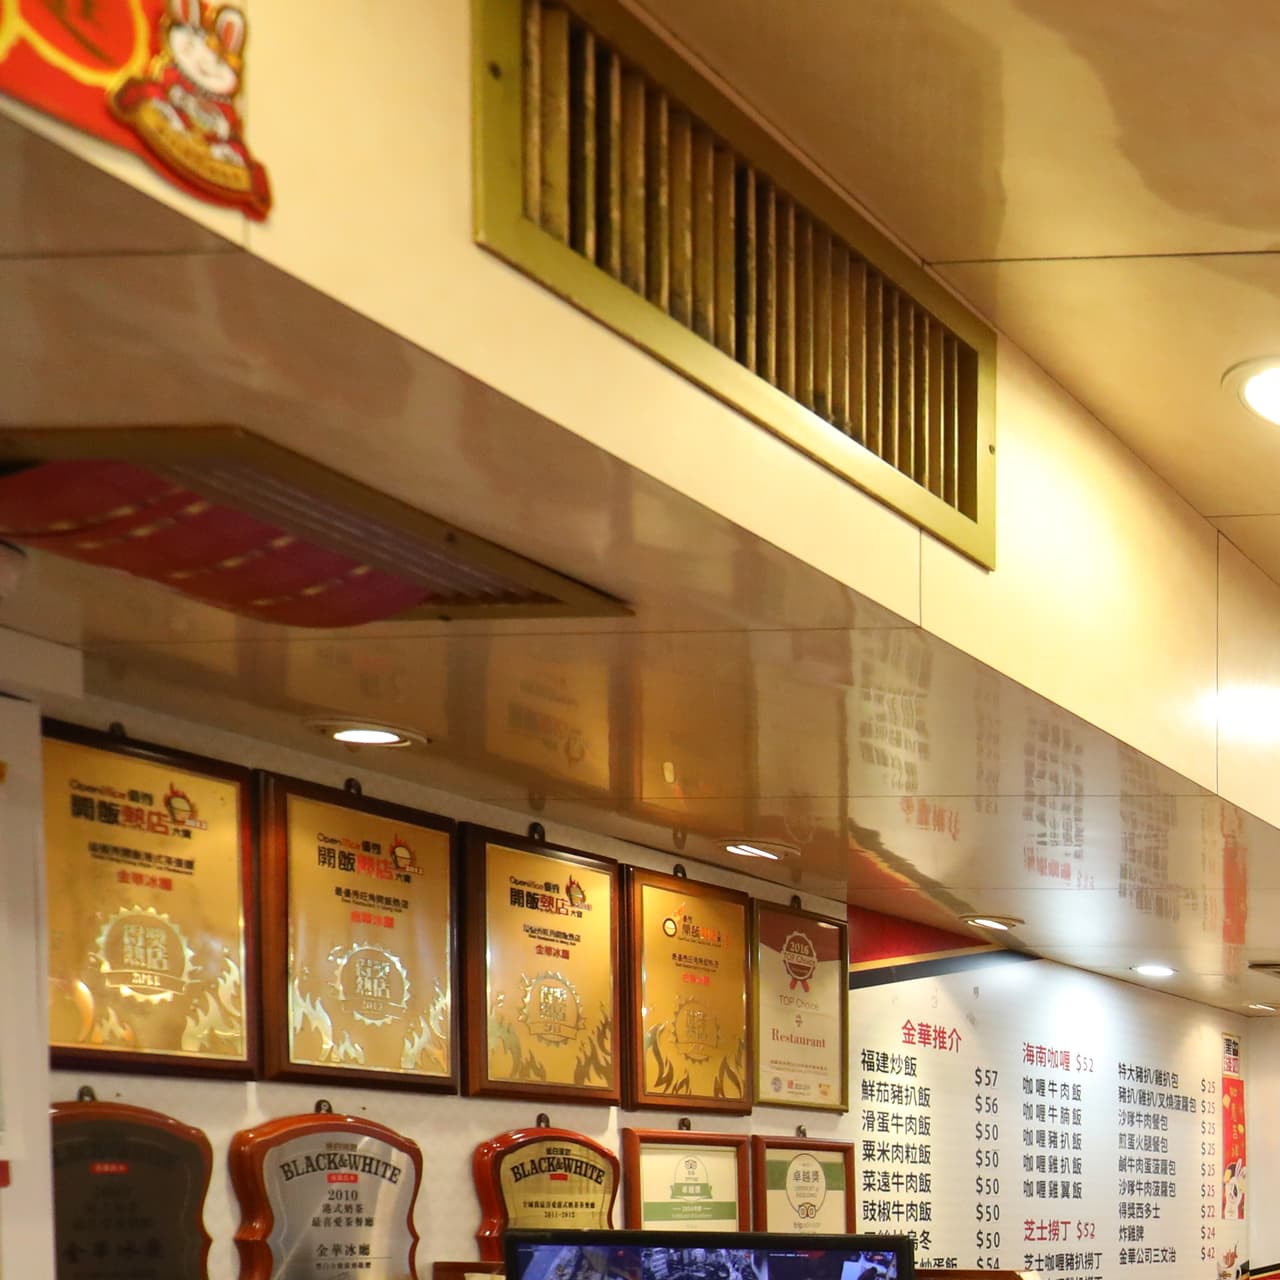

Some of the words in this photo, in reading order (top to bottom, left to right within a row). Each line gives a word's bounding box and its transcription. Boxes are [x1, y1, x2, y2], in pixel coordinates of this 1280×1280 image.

[771, 1028, 826, 1049] Restaurant
[901, 1018, 962, 1053] 金華推介
[860, 1048, 917, 1078] 福建炒飯
[974, 1066, 998, 1087] $57
[1023, 1041, 1071, 1072] 海南咖喱
[1075, 1053, 1095, 1073] $52
[861, 1078, 931, 1108] 鮮茄豬扒飯
[975, 1093, 998, 1114] $56
[1022, 1075, 1082, 1102] 咖喱牛肉飯
[1201, 1079, 1216, 1094] $25
[1201, 1100, 1216, 1114] $25
[861, 1109, 931, 1136] 滑蛋牛肉飯
[975, 1121, 999, 1141] $50
[1201, 1121, 1216, 1135] $25
[862, 1139, 931, 1165] 粟米肉粒飯
[975, 1148, 999, 1168] $50
[1201, 1142, 1216, 1156] $25
[280, 1152, 402, 1185] BLACK&WHITE
[510, 1156, 605, 1186] BLACK&WHITE
[792, 1168, 820, 1184] 卓越獎
[1201, 1163, 1216, 1177] $25
[862, 1169, 931, 1193] 菜遠牛肉飯
[975, 1175, 1000, 1195] $50
[1201, 1184, 1216, 1198] $25
[327, 1188, 359, 1201] 2010
[322, 1203, 364, 1214] 港式奶茶
[862, 1200, 932, 1222] 豉椒牛肉飯
[976, 1202, 1000, 1222] $50
[1201, 1205, 1216, 1219] $22
[976, 1229, 1000, 1250] $50
[1024, 1219, 1071, 1242] 芝士撈丁
[1076, 1219, 1096, 1240] $52
[1201, 1226, 1216, 1240] $24
[316, 1243, 371, 1257] 金華冰廳
[1201, 1247, 1216, 1261] $42
